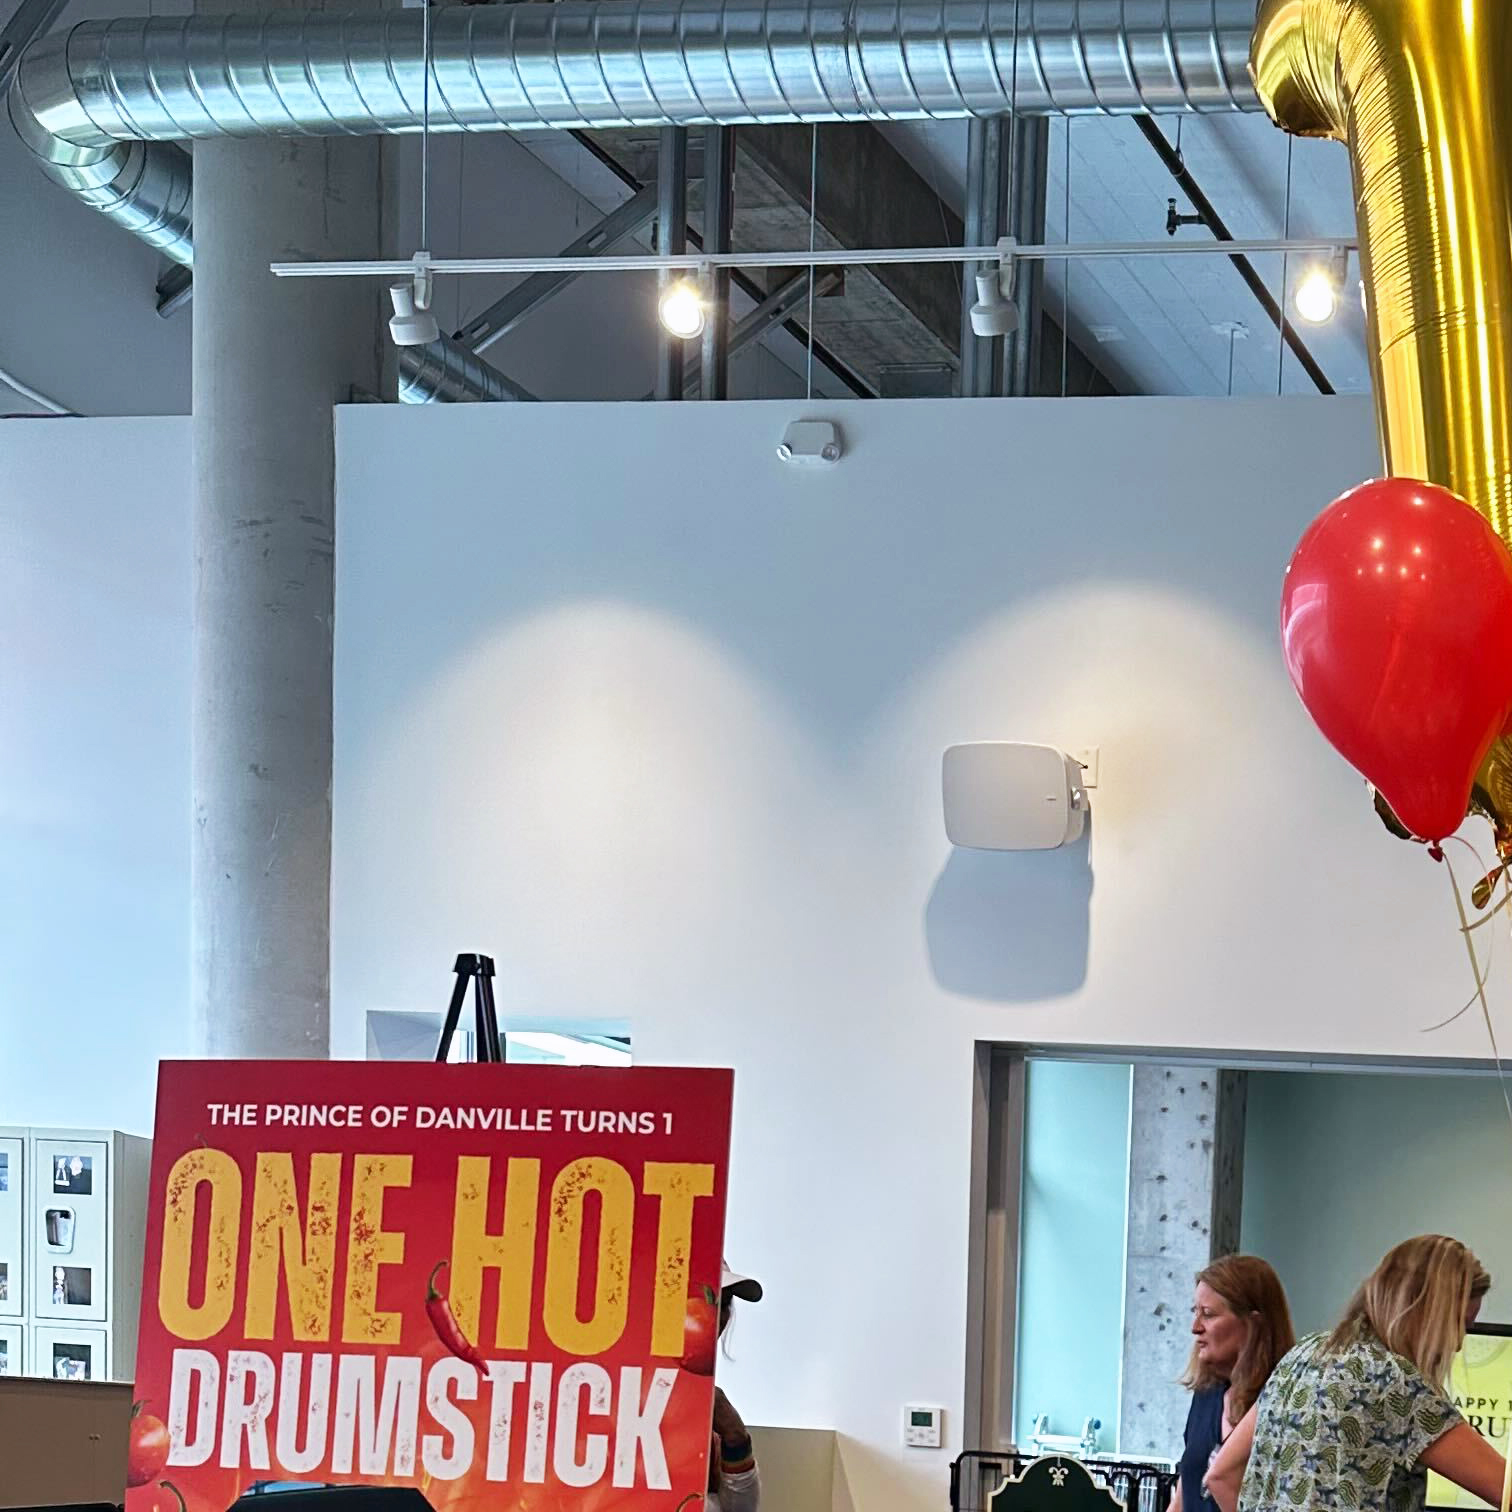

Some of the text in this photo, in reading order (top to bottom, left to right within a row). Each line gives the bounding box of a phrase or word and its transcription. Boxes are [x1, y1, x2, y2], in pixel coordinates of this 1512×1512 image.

[207, 1104, 674, 1135] THE PRINCE OF DANVILLE TURNS 1
[158, 1147, 715, 1357] ONE HOT
[167, 1348, 680, 1490] DRUMSTICK
[1454, 1396, 1499, 1411] APPY
